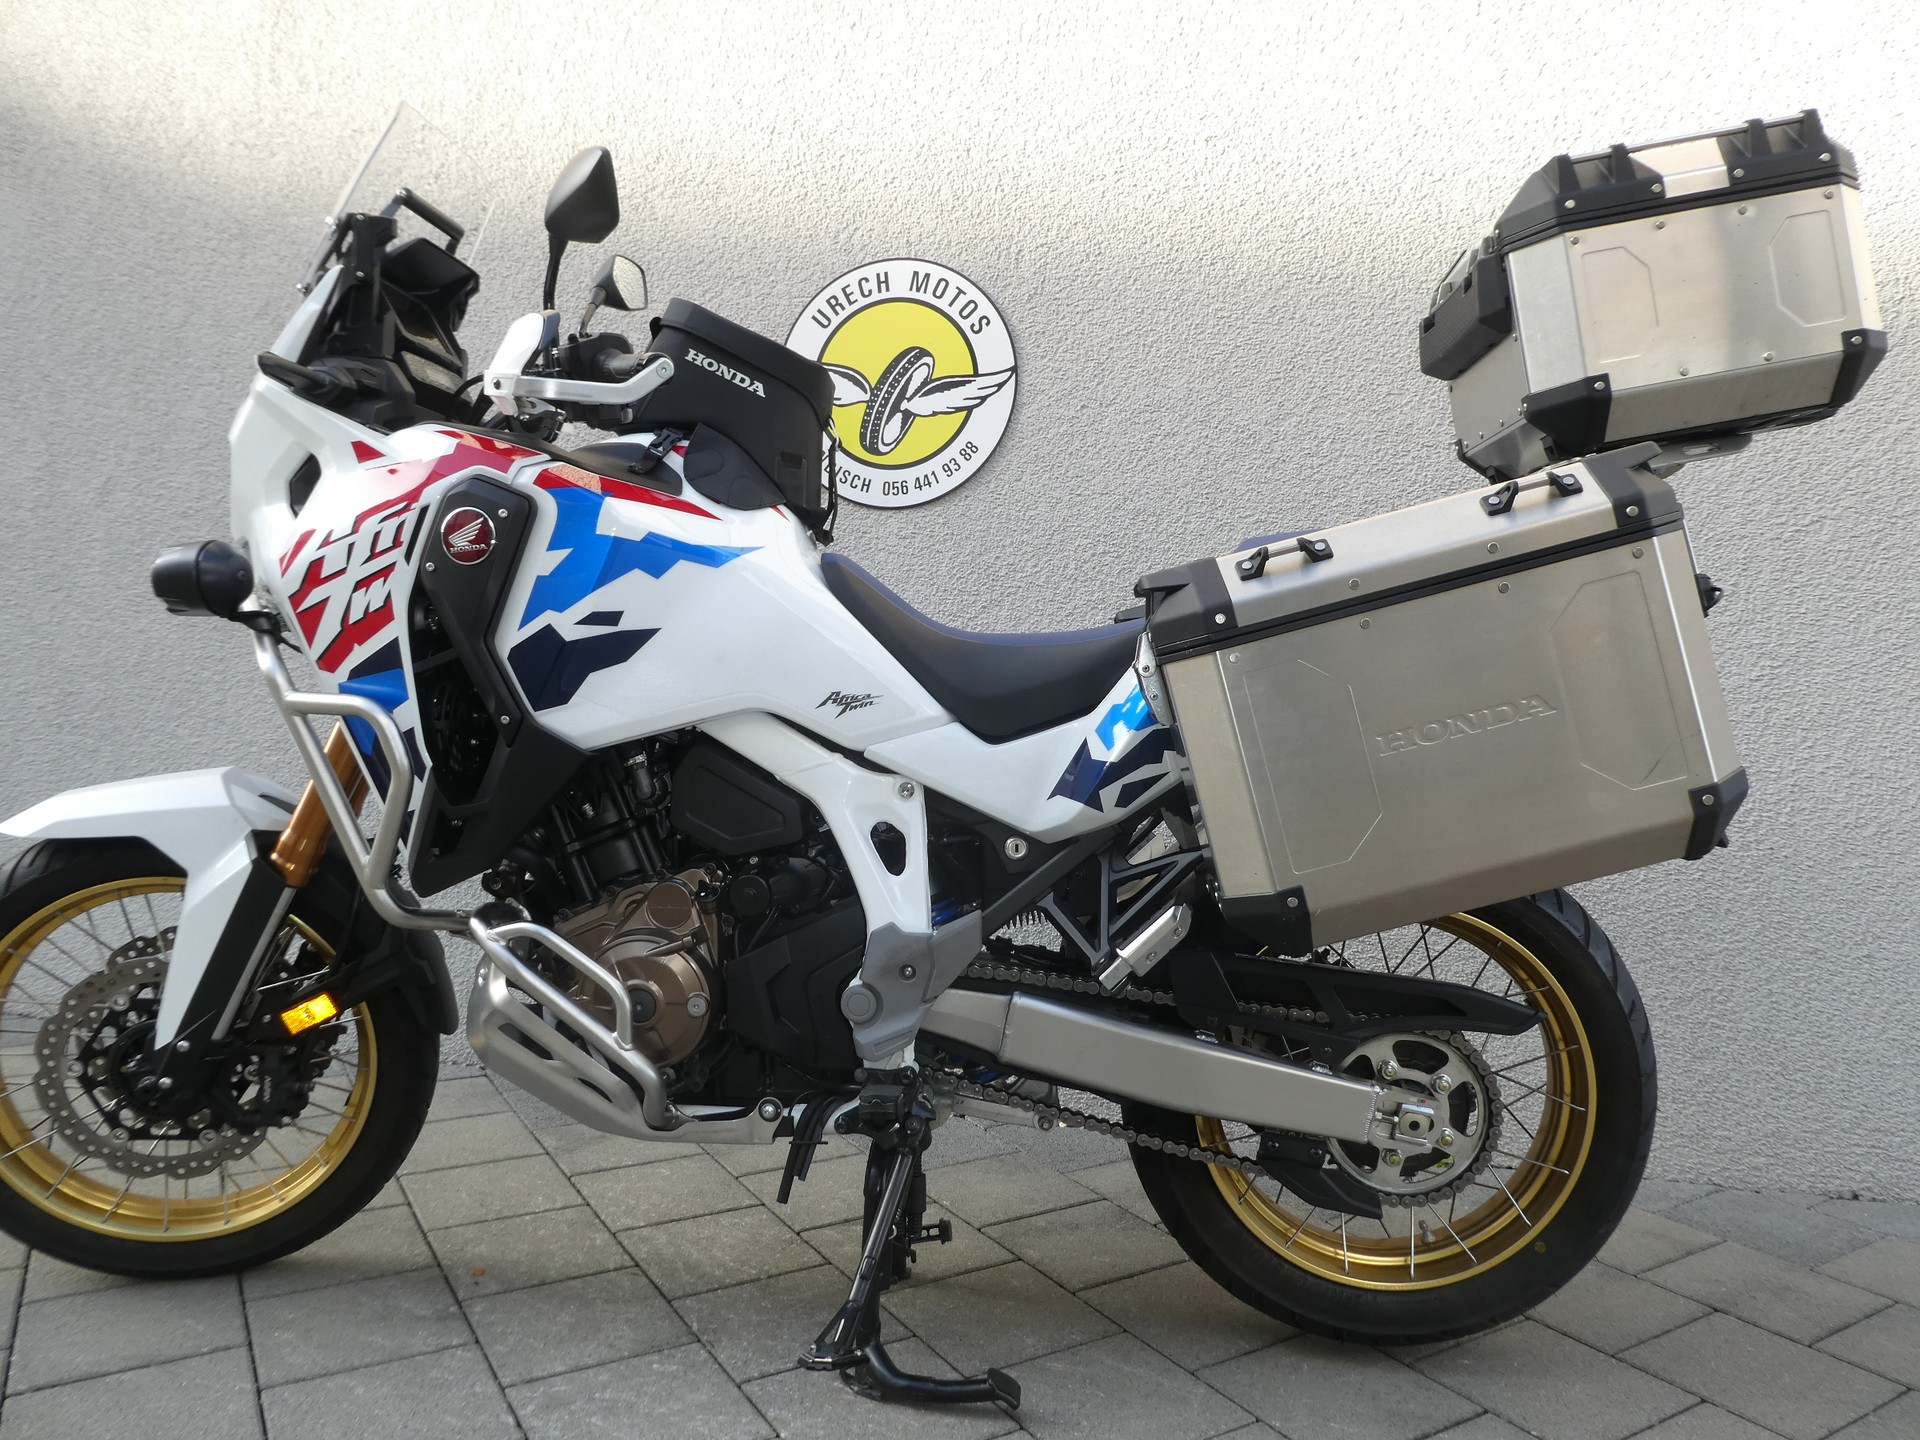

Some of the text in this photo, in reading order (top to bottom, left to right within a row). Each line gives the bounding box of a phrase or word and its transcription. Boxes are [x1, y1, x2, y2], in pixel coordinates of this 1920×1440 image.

[811, 270, 991, 335] URECH MOTOS
[684, 348, 766, 398] HONDA
[882, 480, 909, 496] 056
[914, 470, 940, 491] 441
[942, 457, 961, 478] 93
[959, 440, 979, 462] 88
[449, 543, 488, 554] HONDA
[815, 691, 884, 709] Africa
[834, 700, 880, 720] Twin
[1375, 694, 1557, 757] HONDA
